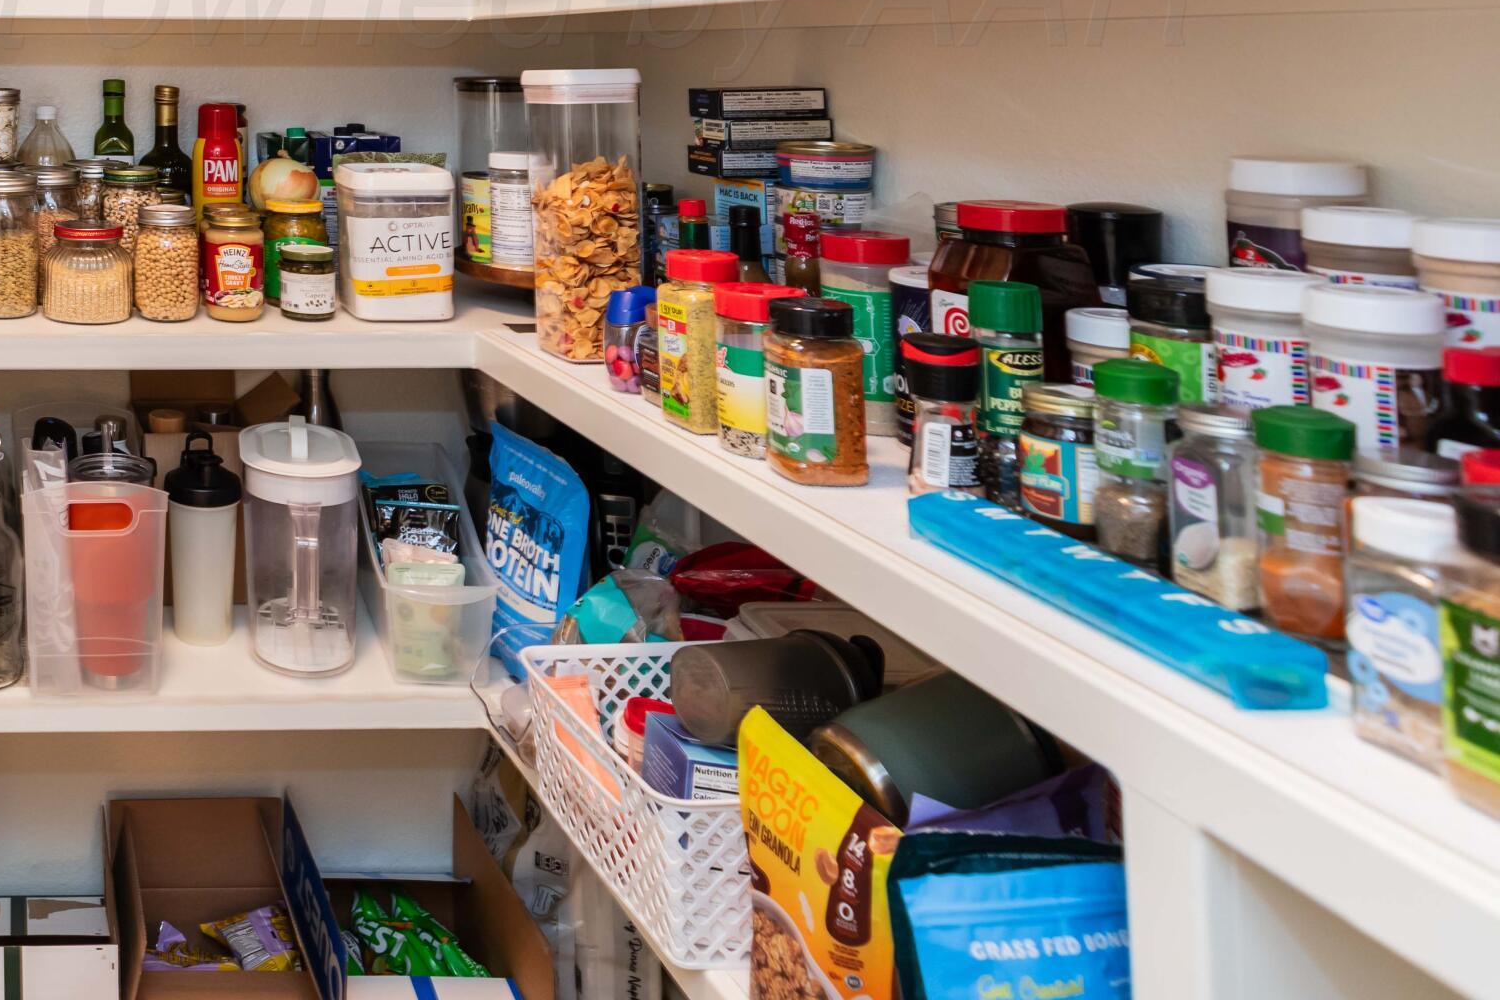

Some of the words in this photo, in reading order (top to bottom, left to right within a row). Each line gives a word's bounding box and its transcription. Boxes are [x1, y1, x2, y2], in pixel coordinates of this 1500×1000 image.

[204, 159, 238, 183] PAM
[719, 188, 732, 197] MAC
[740, 191, 758, 201] BACK
[223, 248, 247, 258] HEINZ
[369, 231, 453, 254] ACTIVE
[1001, 353, 1043, 366] ALESS
[990, 397, 1026, 411] PEPP
[512, 526, 560, 573] BROTH
[486, 530, 560, 603] ROTEIN
[695, 766, 734, 779] Nutrition
[747, 778, 808, 851] POON
[759, 824, 802, 877] GRANOLA
[968, 938, 1040, 961] GRASS
[1041, 935, 1082, 957] FED
